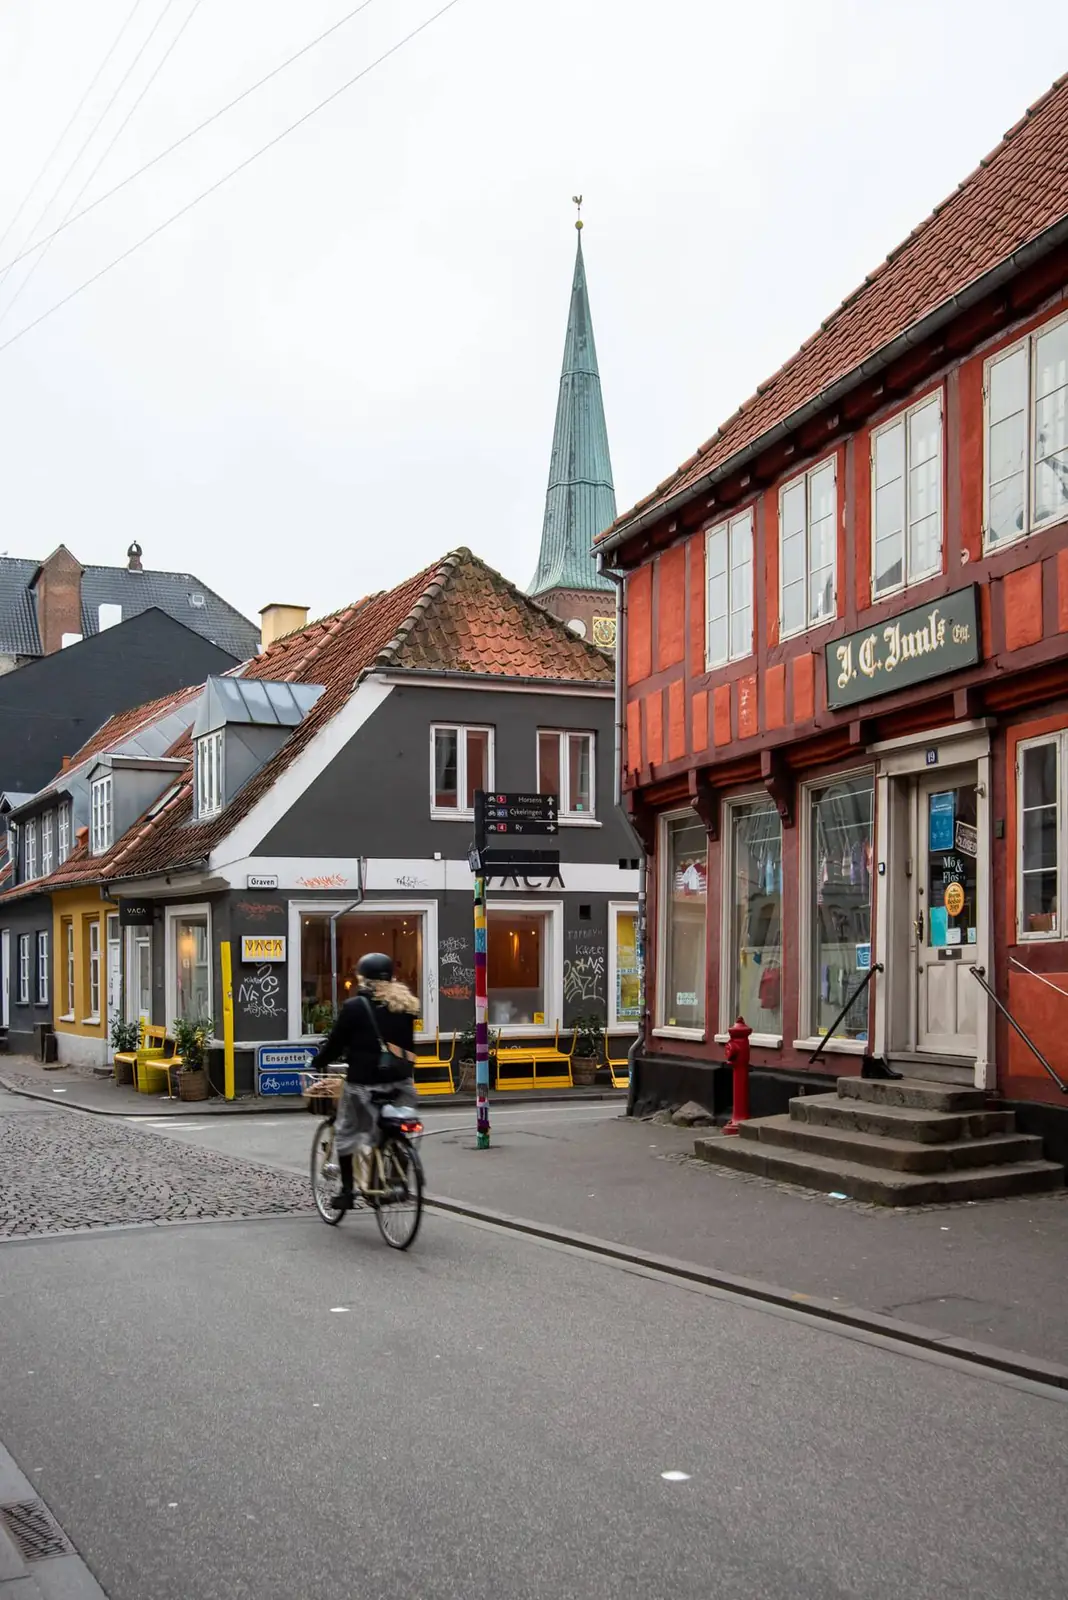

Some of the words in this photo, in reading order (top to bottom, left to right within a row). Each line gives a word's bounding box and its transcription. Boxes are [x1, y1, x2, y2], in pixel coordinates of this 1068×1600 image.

[884, 608, 946, 672] Juuls
[927, 751, 935, 763] 19
[518, 796, 542, 804] Horsens
[510, 808, 543, 818] Cykelringen
[515, 824, 523, 832] Ry
[955, 859, 964, 873] &
[250, 877, 275, 887] Graven
[245, 941, 283, 951] VACA
[265, 1054, 306, 1063] Ensrettet
